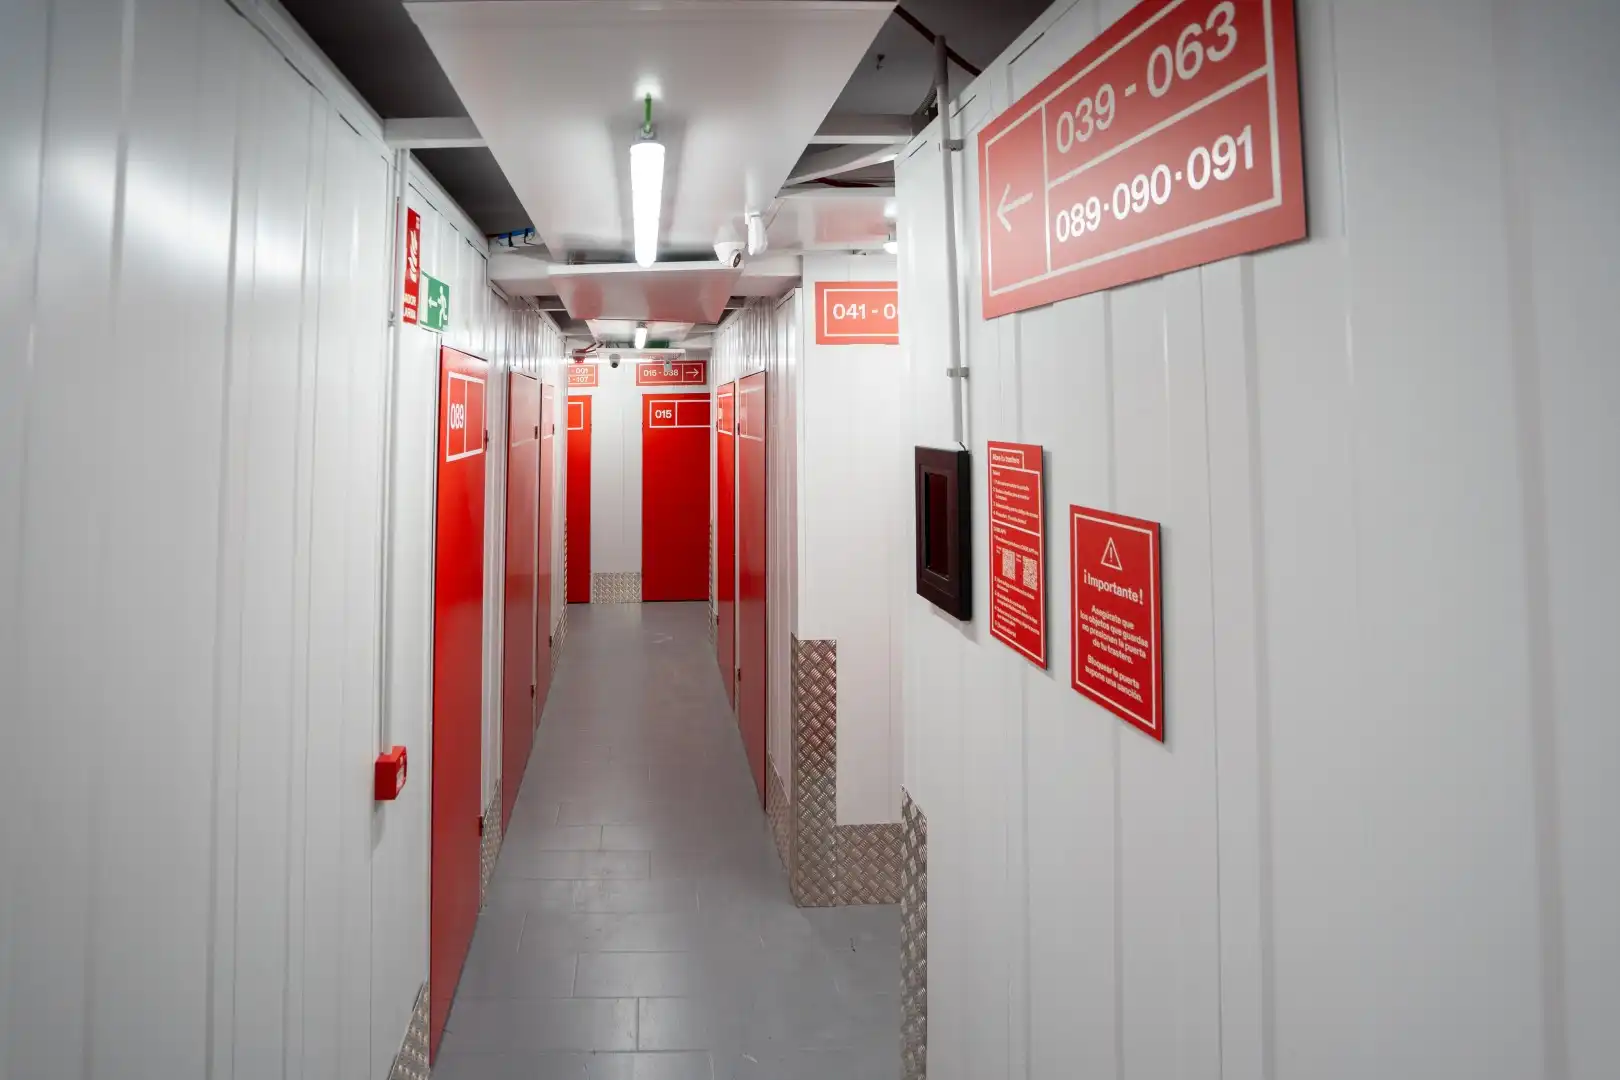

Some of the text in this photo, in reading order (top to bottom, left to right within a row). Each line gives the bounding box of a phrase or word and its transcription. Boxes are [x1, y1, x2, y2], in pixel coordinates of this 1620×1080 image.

[1056, 83, 1115, 153] 039
[1147, 1, 1238, 98] 063
[832, 303, 866, 320] 041
[883, 303, 899, 320] 0
[643, 369, 657, 377] 015
[450, 403, 465, 430] 089
[655, 409, 672, 419] 015
[1088, 615, 1110, 630] objetos
[1110, 625, 1123, 636] que
[1122, 630, 1149, 648] guardas
[1125, 643, 1147, 659] puerta
[1118, 672, 1140, 690] puerta
